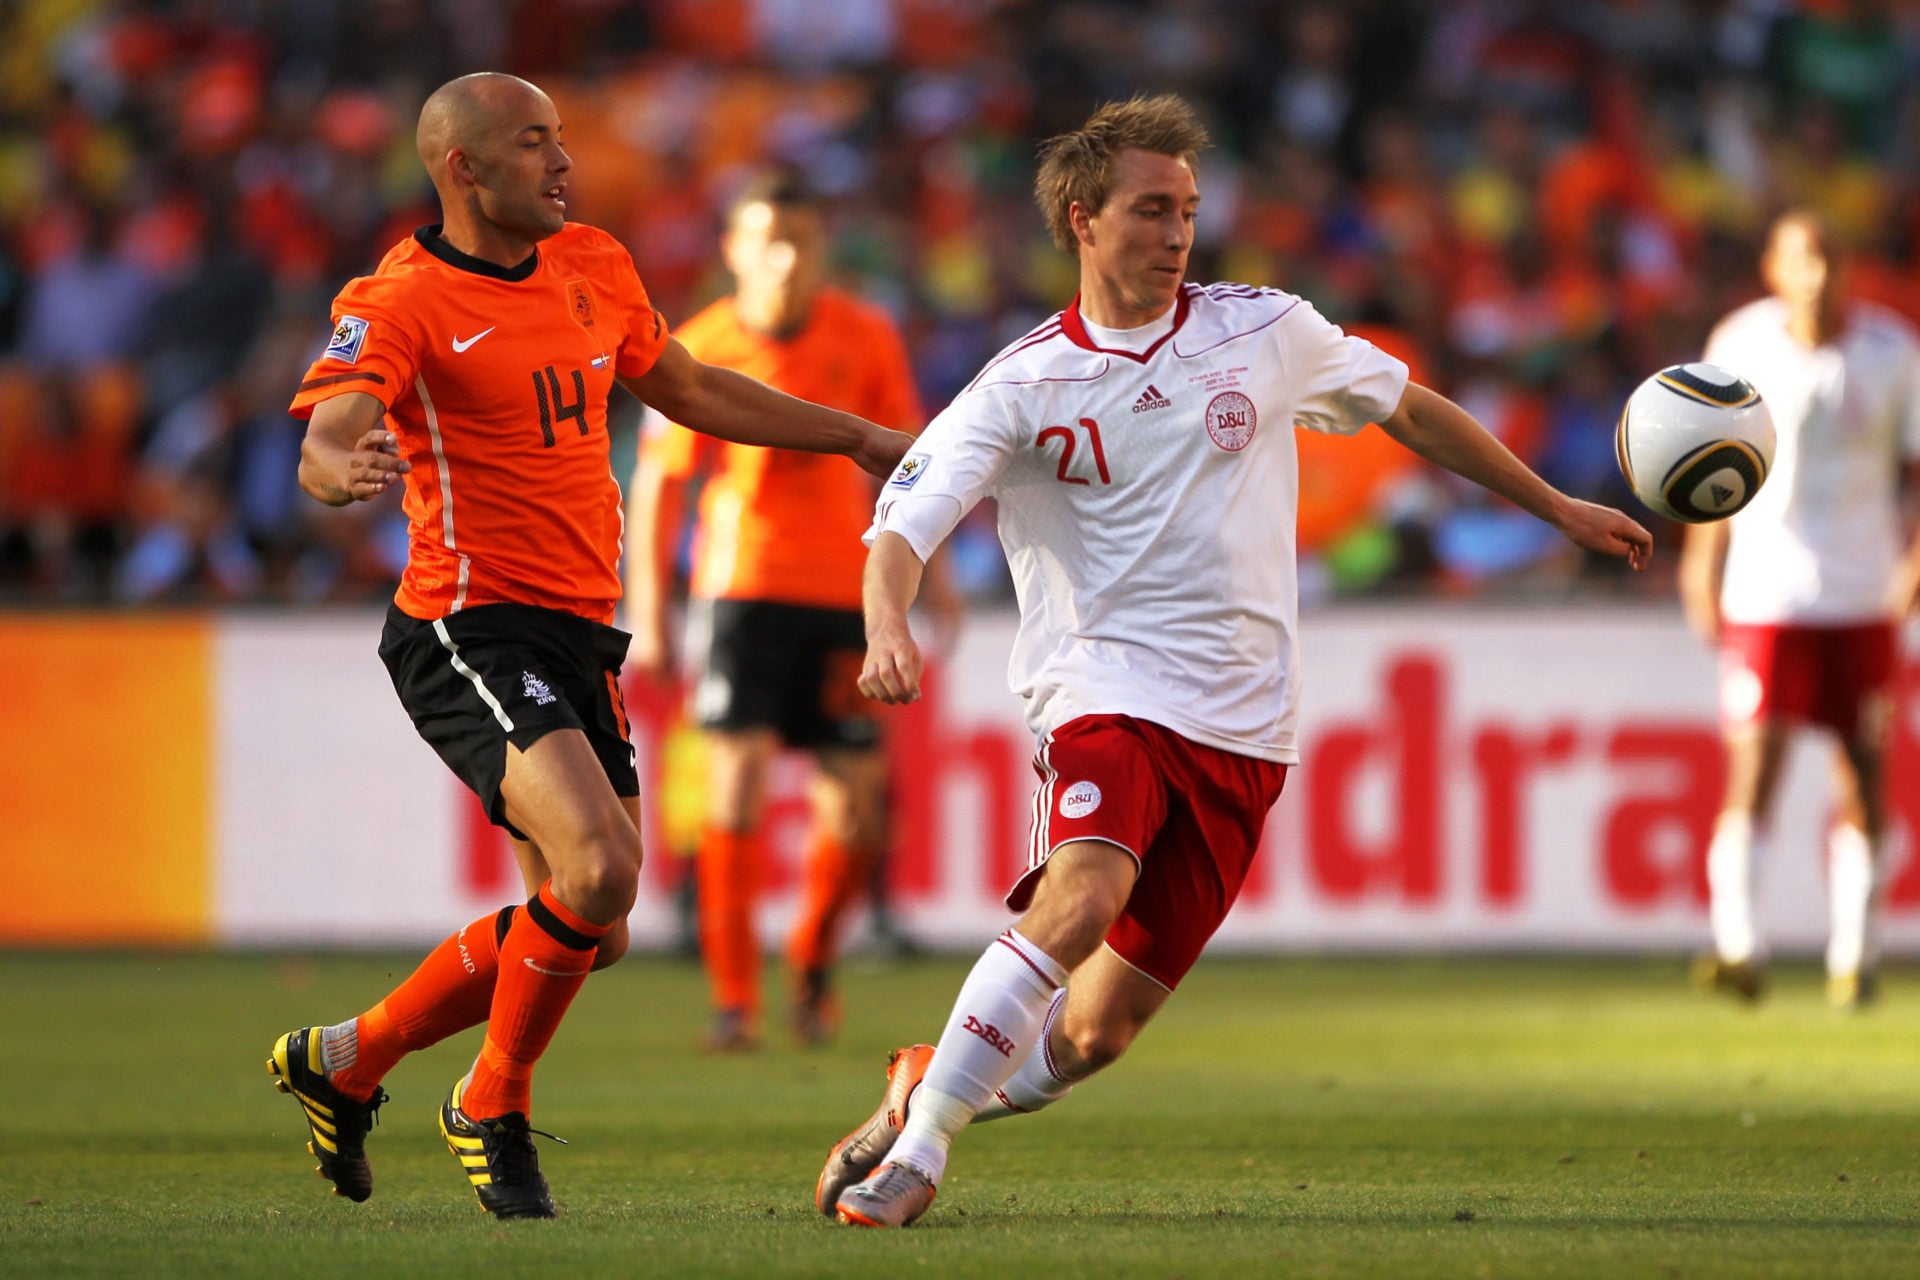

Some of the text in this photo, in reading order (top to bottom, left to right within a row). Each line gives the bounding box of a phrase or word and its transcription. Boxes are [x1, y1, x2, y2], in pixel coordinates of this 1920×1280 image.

[532, 365, 589, 449] 14
[1132, 398, 1172, 414] adidas
[1217, 411, 1246, 429] DBU
[1036, 417, 1111, 485] 21
[536, 695, 557, 706] KNVB
[1067, 793, 1092, 806] DBU
[962, 1015, 1016, 1058] DBU
